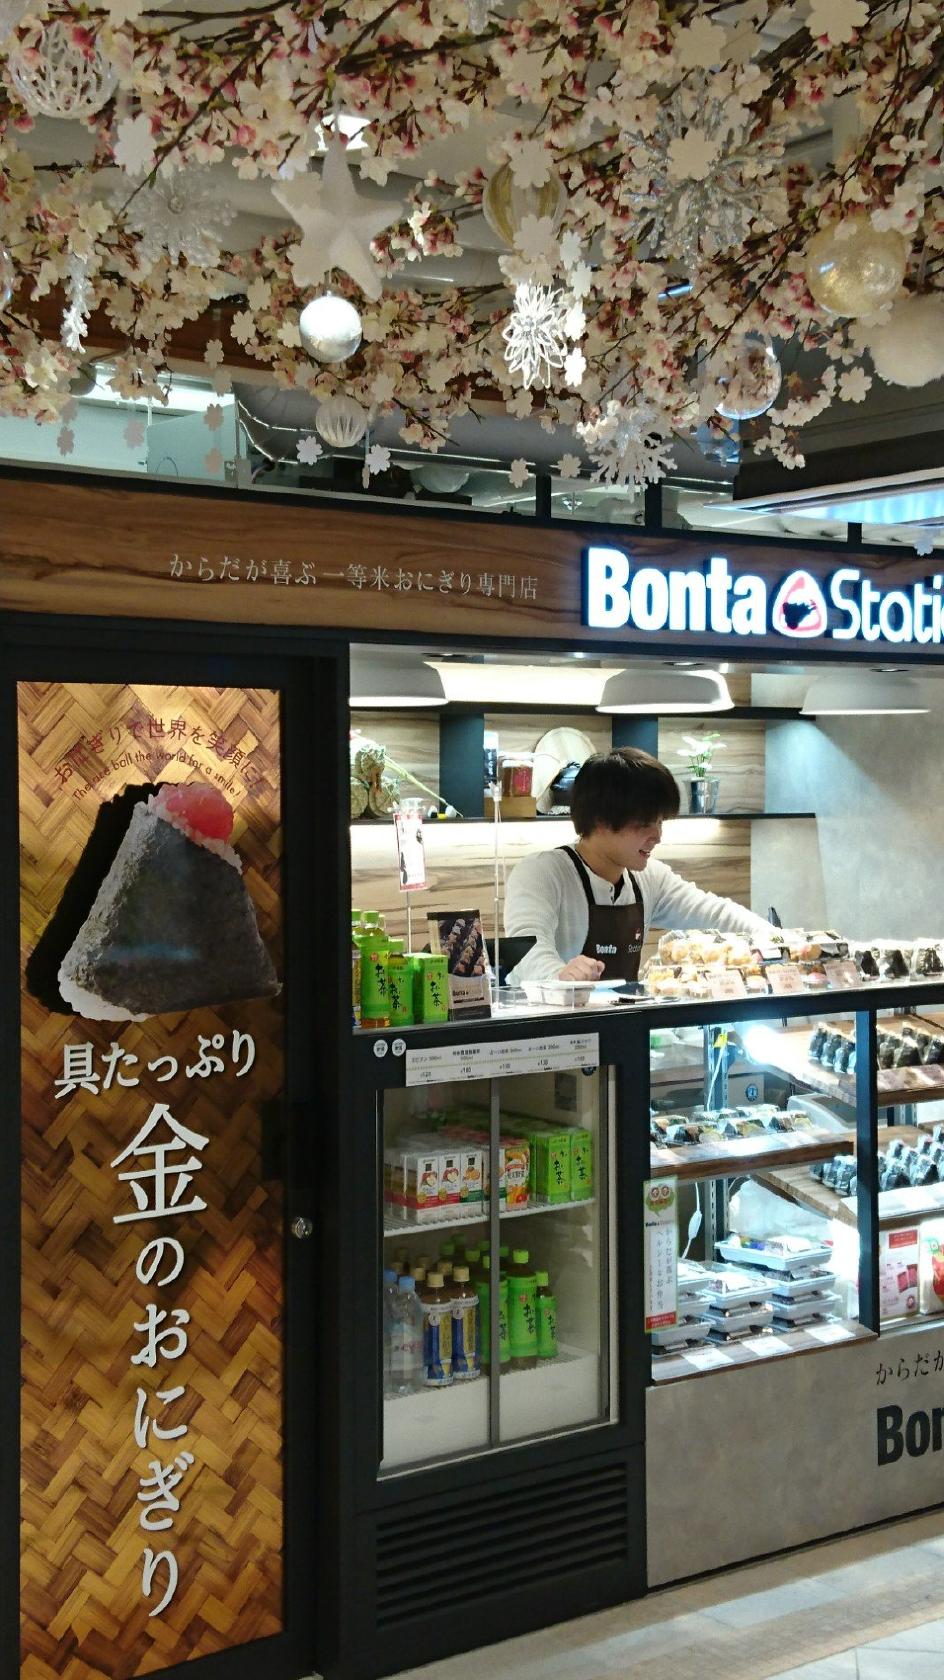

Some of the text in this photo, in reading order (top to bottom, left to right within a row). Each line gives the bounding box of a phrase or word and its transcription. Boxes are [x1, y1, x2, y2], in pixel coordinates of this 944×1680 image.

[587, 547, 944, 643] Bonta Stati
[111, 752, 133, 771] ball
[135, 750, 152, 762] the
[157, 748, 187, 763] world
[188, 754, 204, 768] for
[205, 767, 213, 775] a
[54, 1029, 256, 1099] 具たっぷり
[110, 1103, 208, 1618] 金のおにぎり
